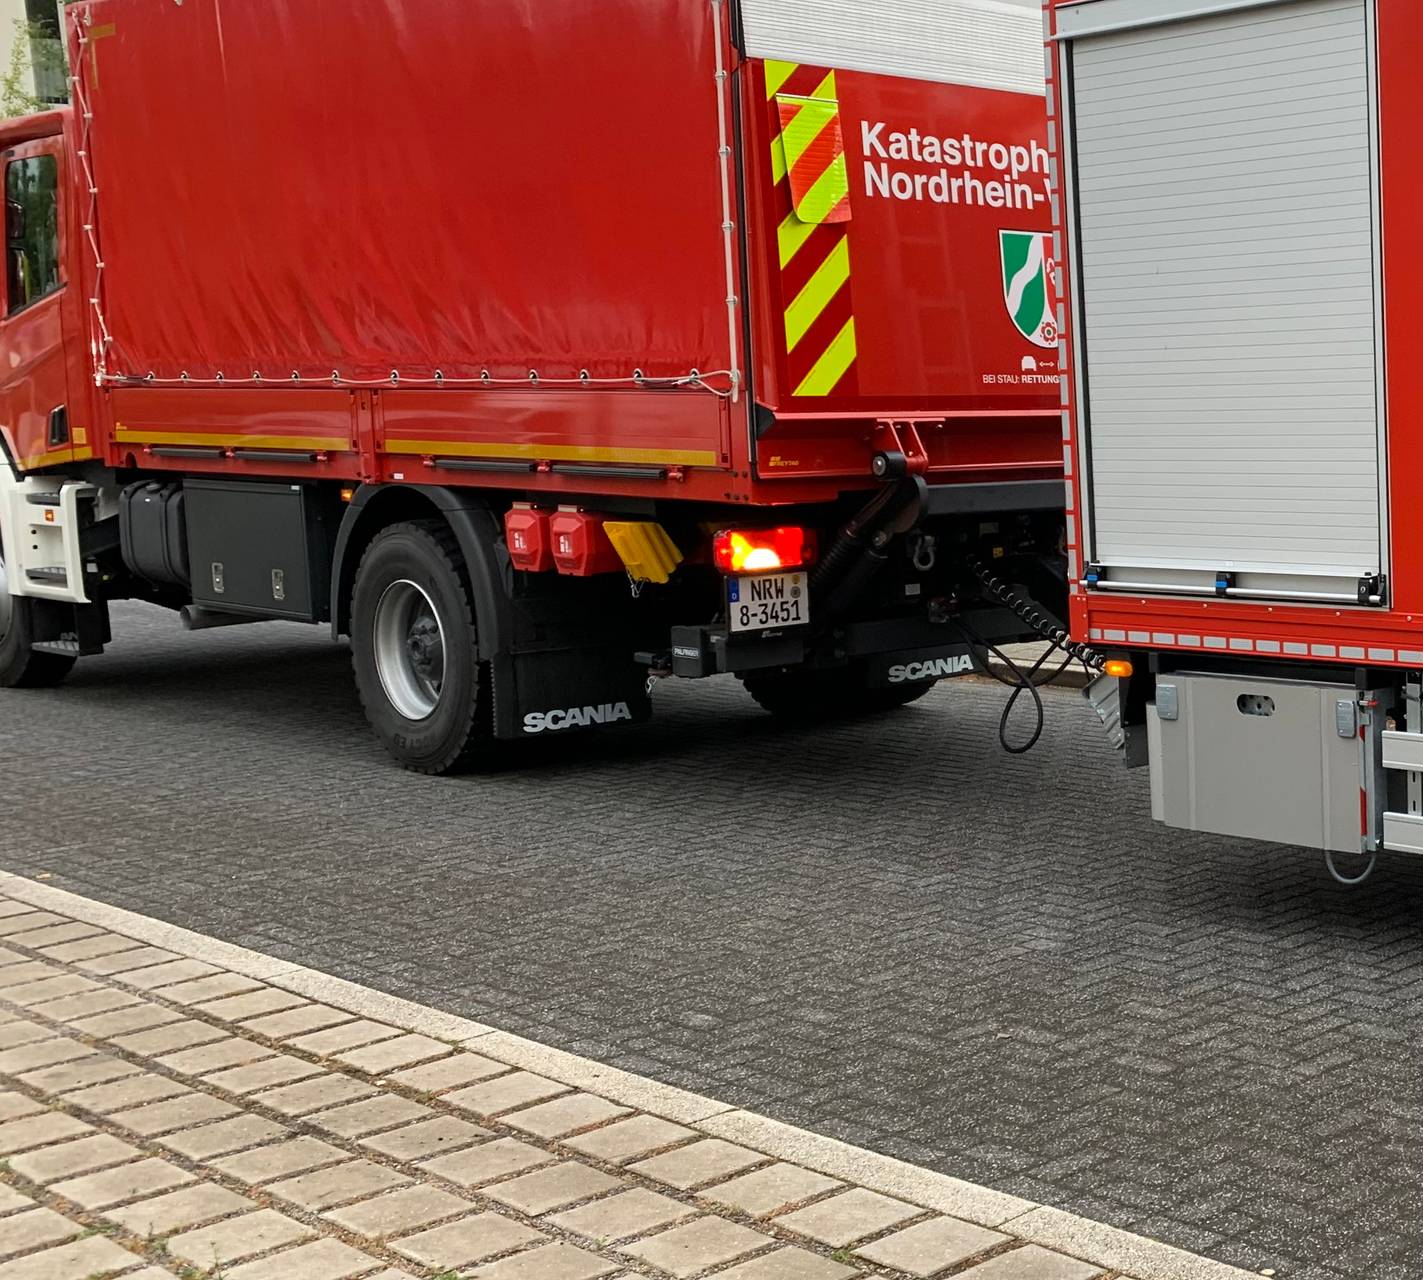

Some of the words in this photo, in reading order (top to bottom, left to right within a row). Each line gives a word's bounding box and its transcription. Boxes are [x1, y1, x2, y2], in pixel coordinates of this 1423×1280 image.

[864, 161, 1051, 210] Nordrhein-
[982, 374, 996, 384] BEI
[997, 374, 1020, 384] STAU:
[1021, 374, 1060, 384] RETTUNG
[750, 577, 785, 602] NRW
[740, 599, 801, 627] 8-3451
[888, 653, 975, 683] SCANIA
[522, 701, 632, 734] SCANIA
